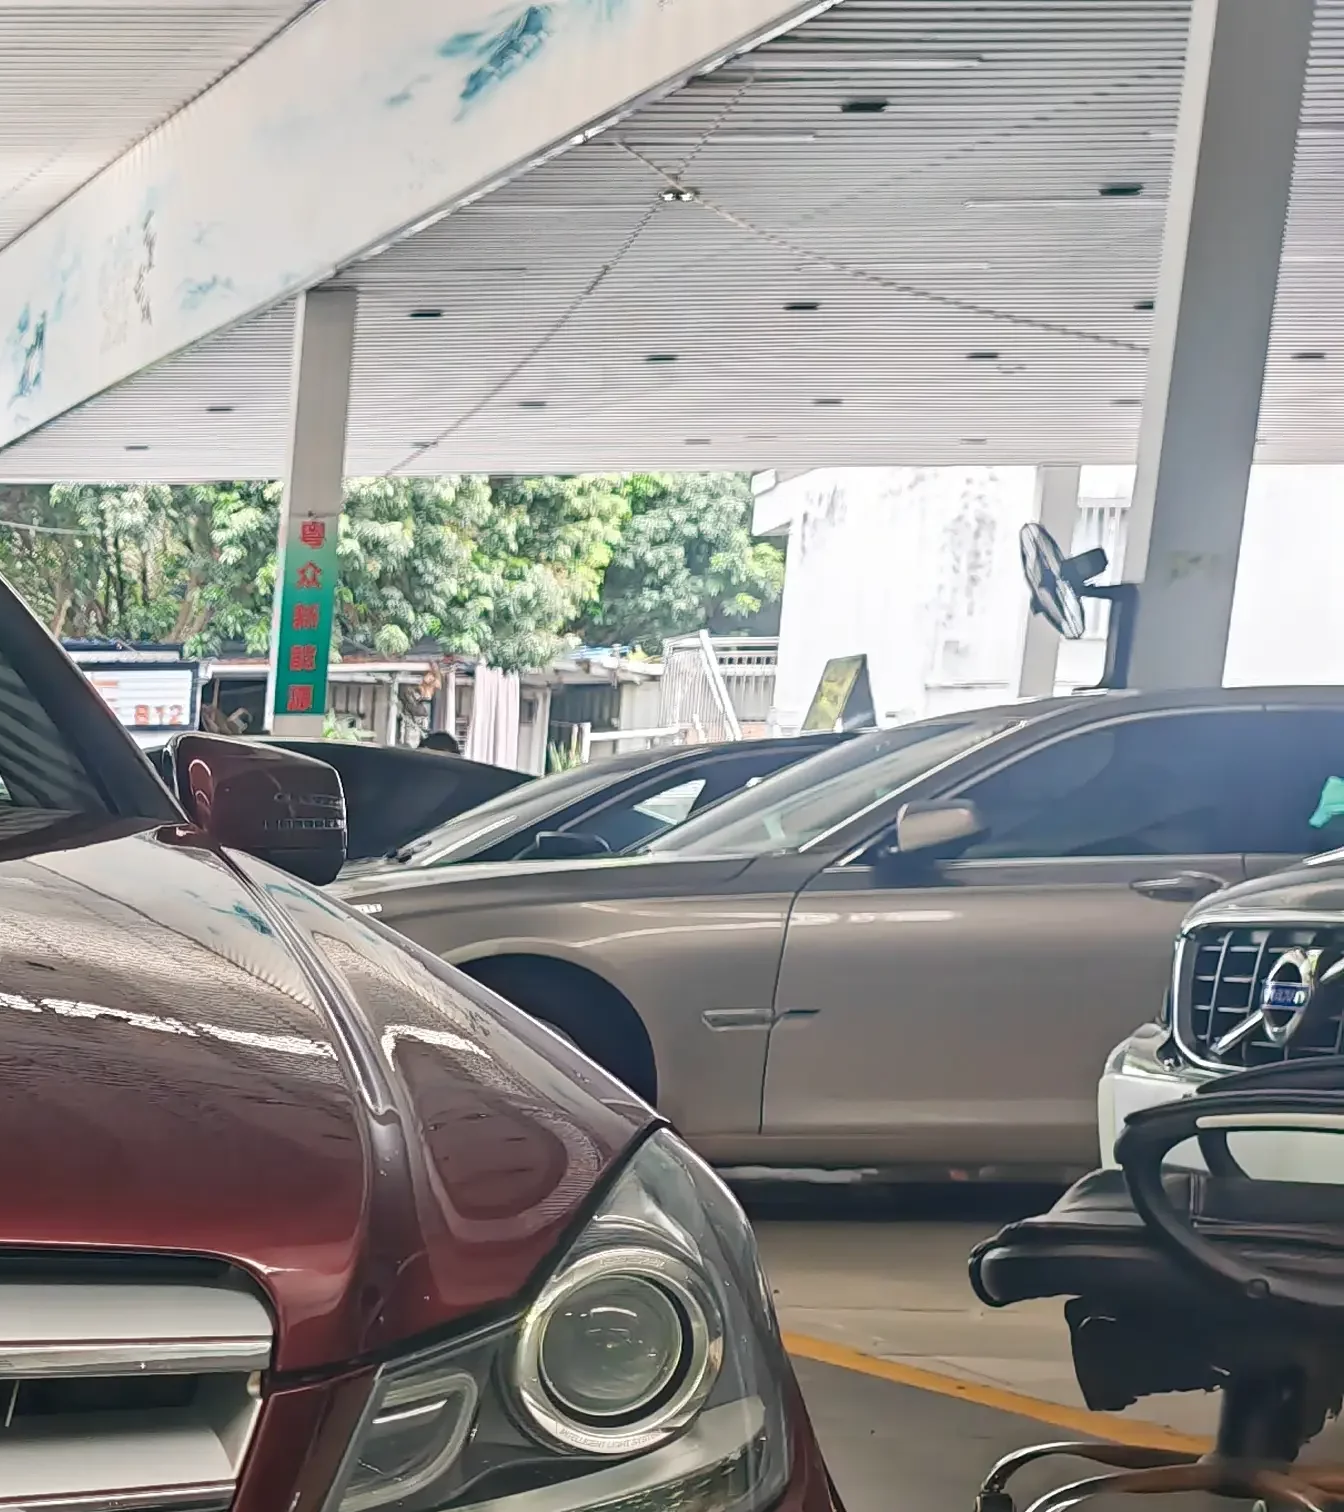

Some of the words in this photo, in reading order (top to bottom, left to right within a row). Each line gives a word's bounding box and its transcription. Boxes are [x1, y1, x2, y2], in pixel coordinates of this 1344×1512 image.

[287, 519, 327, 712] 粤众新能源
